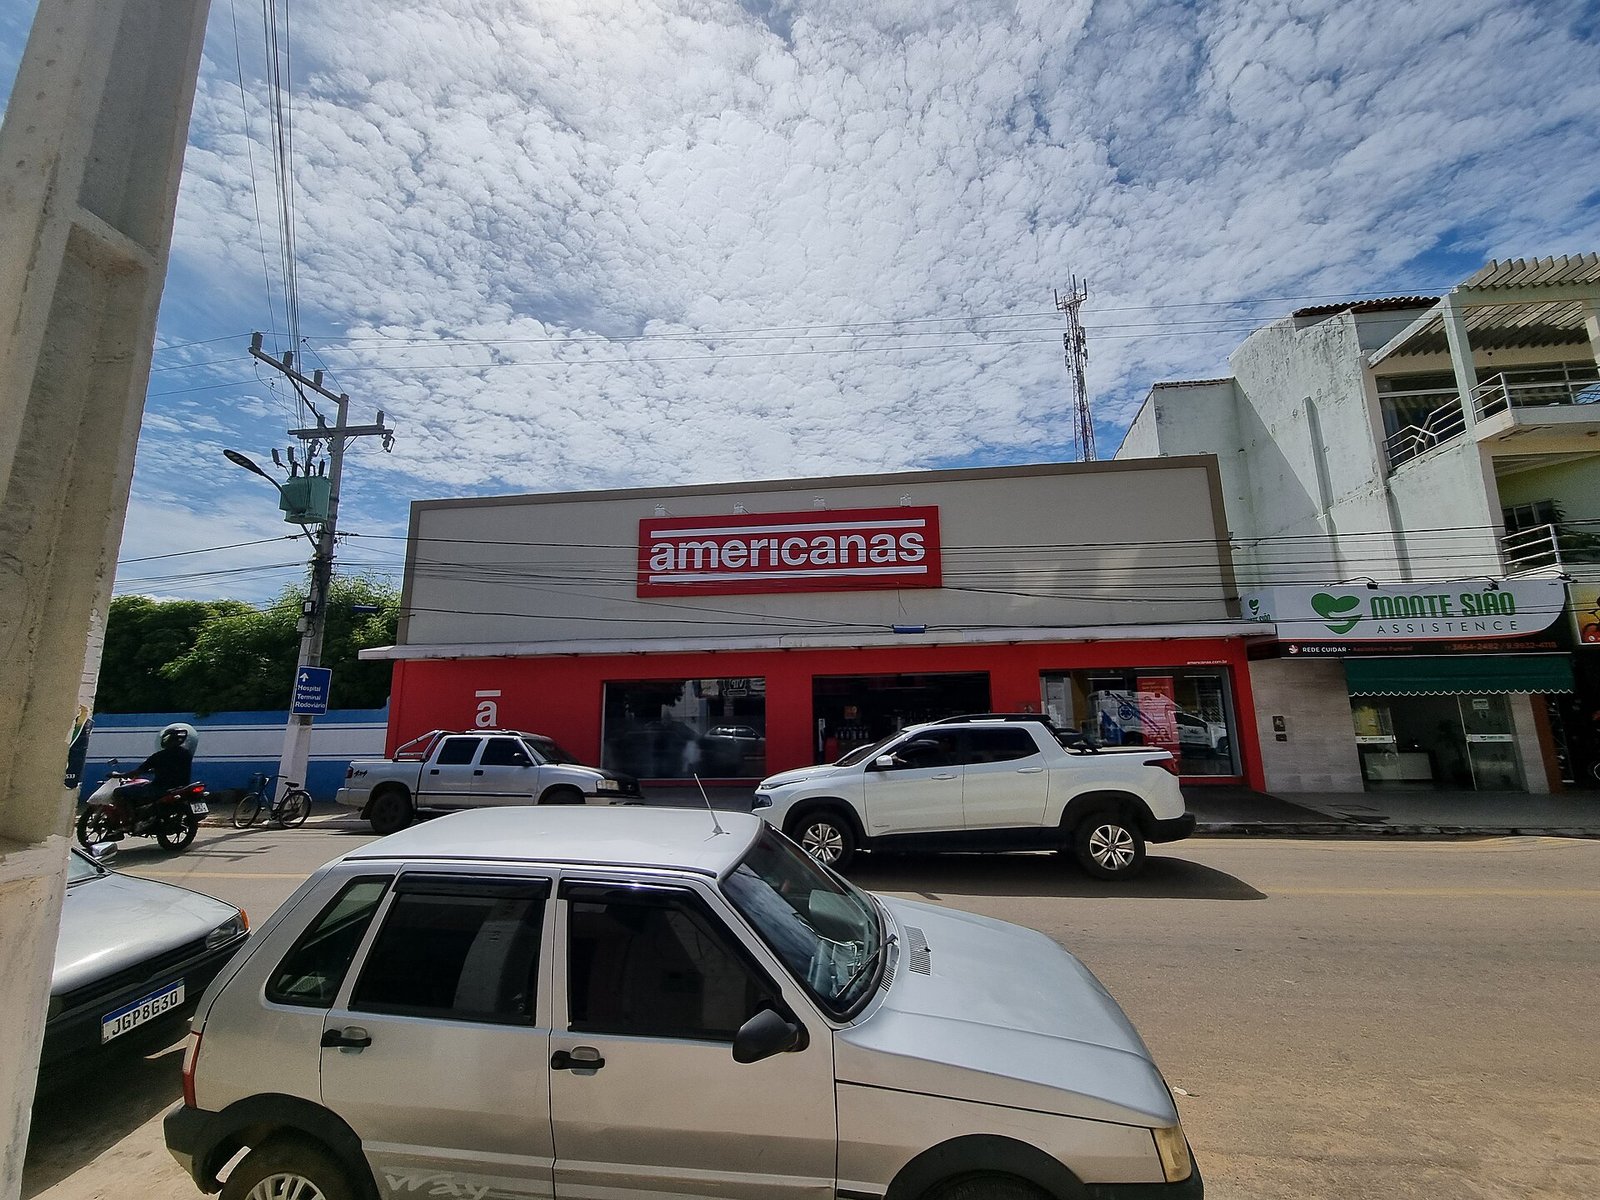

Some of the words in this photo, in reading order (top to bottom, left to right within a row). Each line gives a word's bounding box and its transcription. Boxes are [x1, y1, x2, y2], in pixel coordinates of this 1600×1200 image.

[649, 531, 926, 571] americanas
[1370, 594, 1454, 619] MONTE
[1376, 620, 1518, 634] ASSISTENCE
[297, 684, 321, 692] Hospital
[297, 693, 321, 701] Terminal
[111, 990, 178, 1036] JGP8G30
